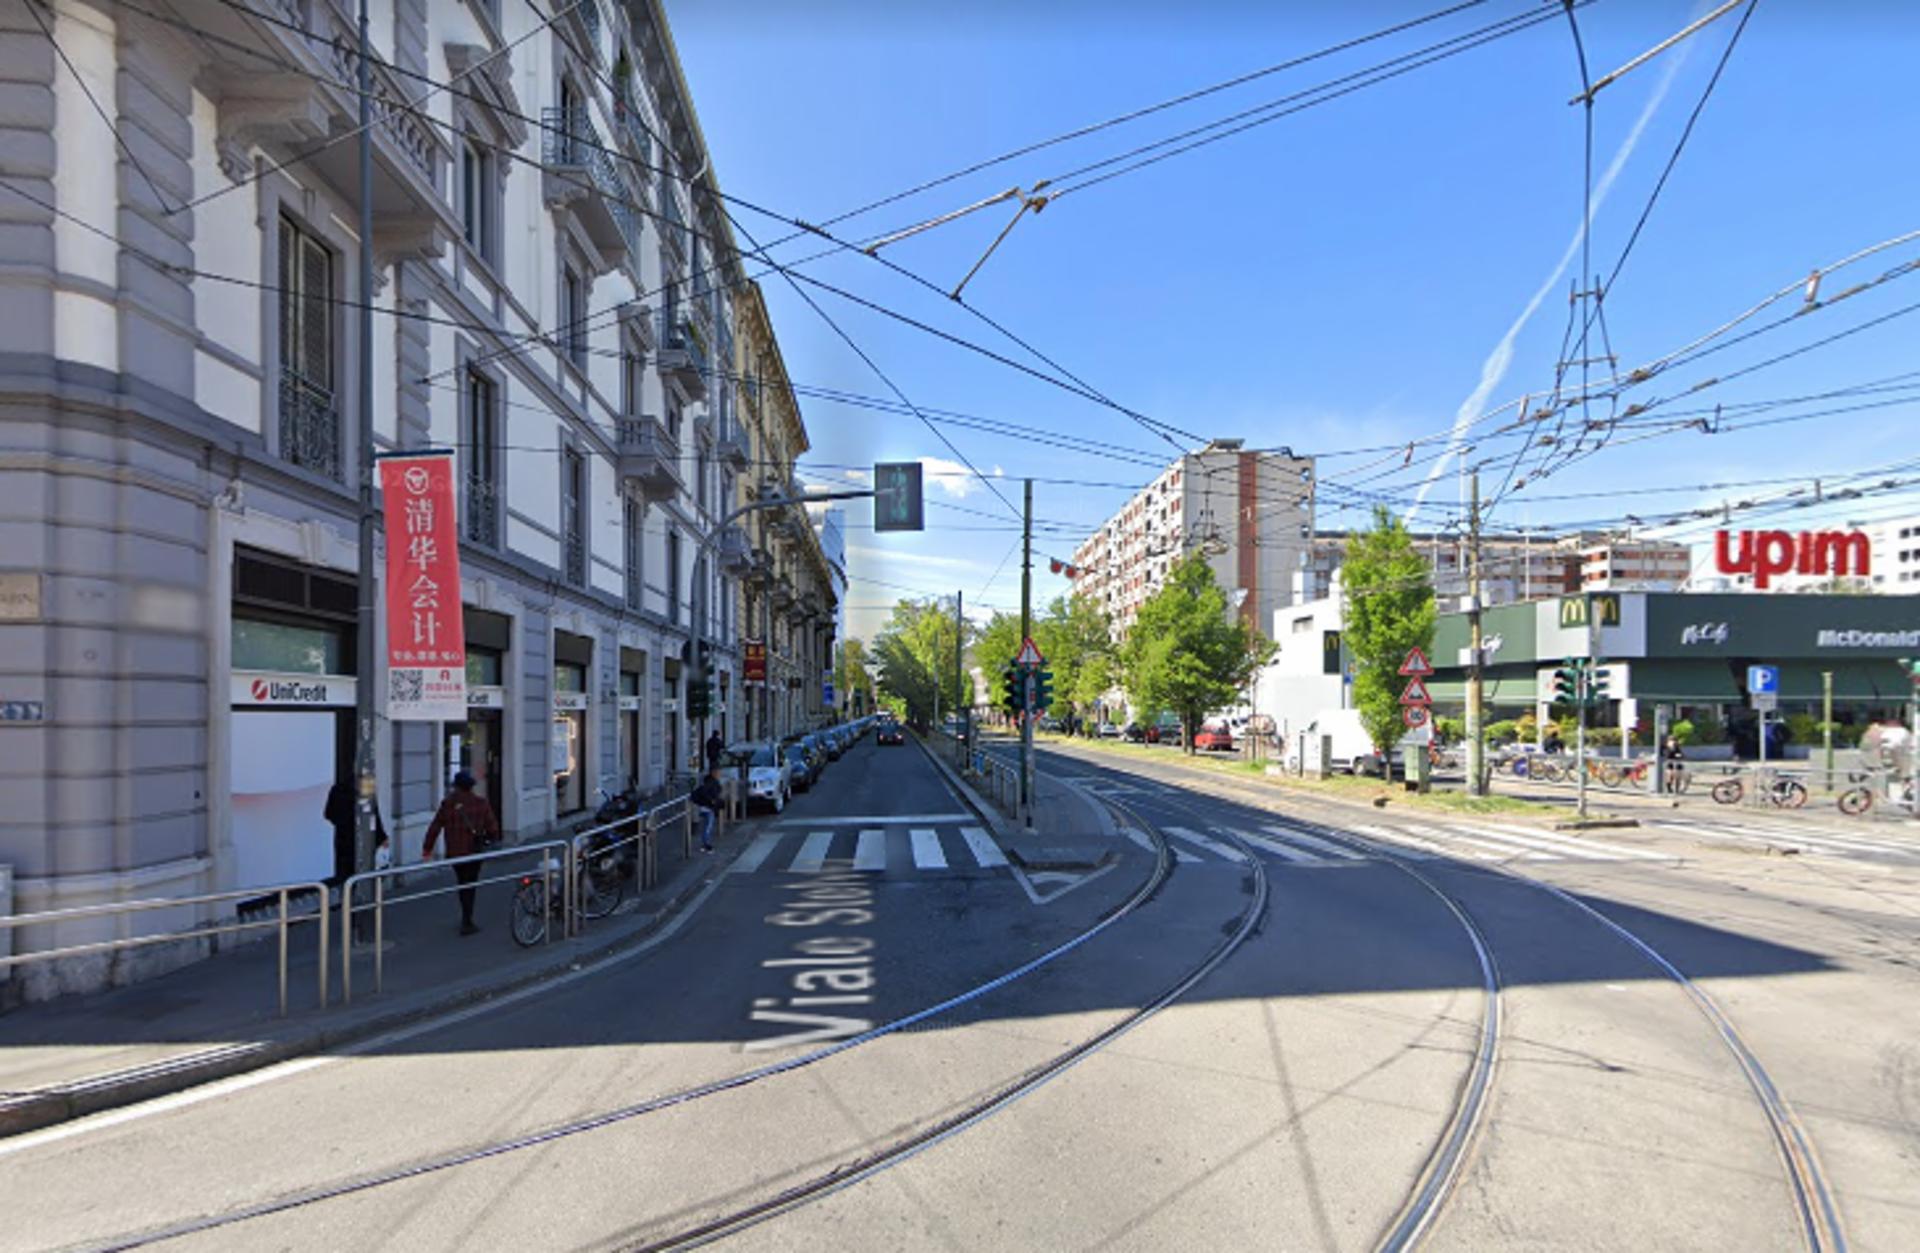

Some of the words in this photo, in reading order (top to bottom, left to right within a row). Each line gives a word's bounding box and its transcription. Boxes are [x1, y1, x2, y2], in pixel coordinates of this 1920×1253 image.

[404, 498, 441, 647] 清华会计
[1716, 530, 1871, 589] upim
[269, 682, 327, 702] UniCredit
